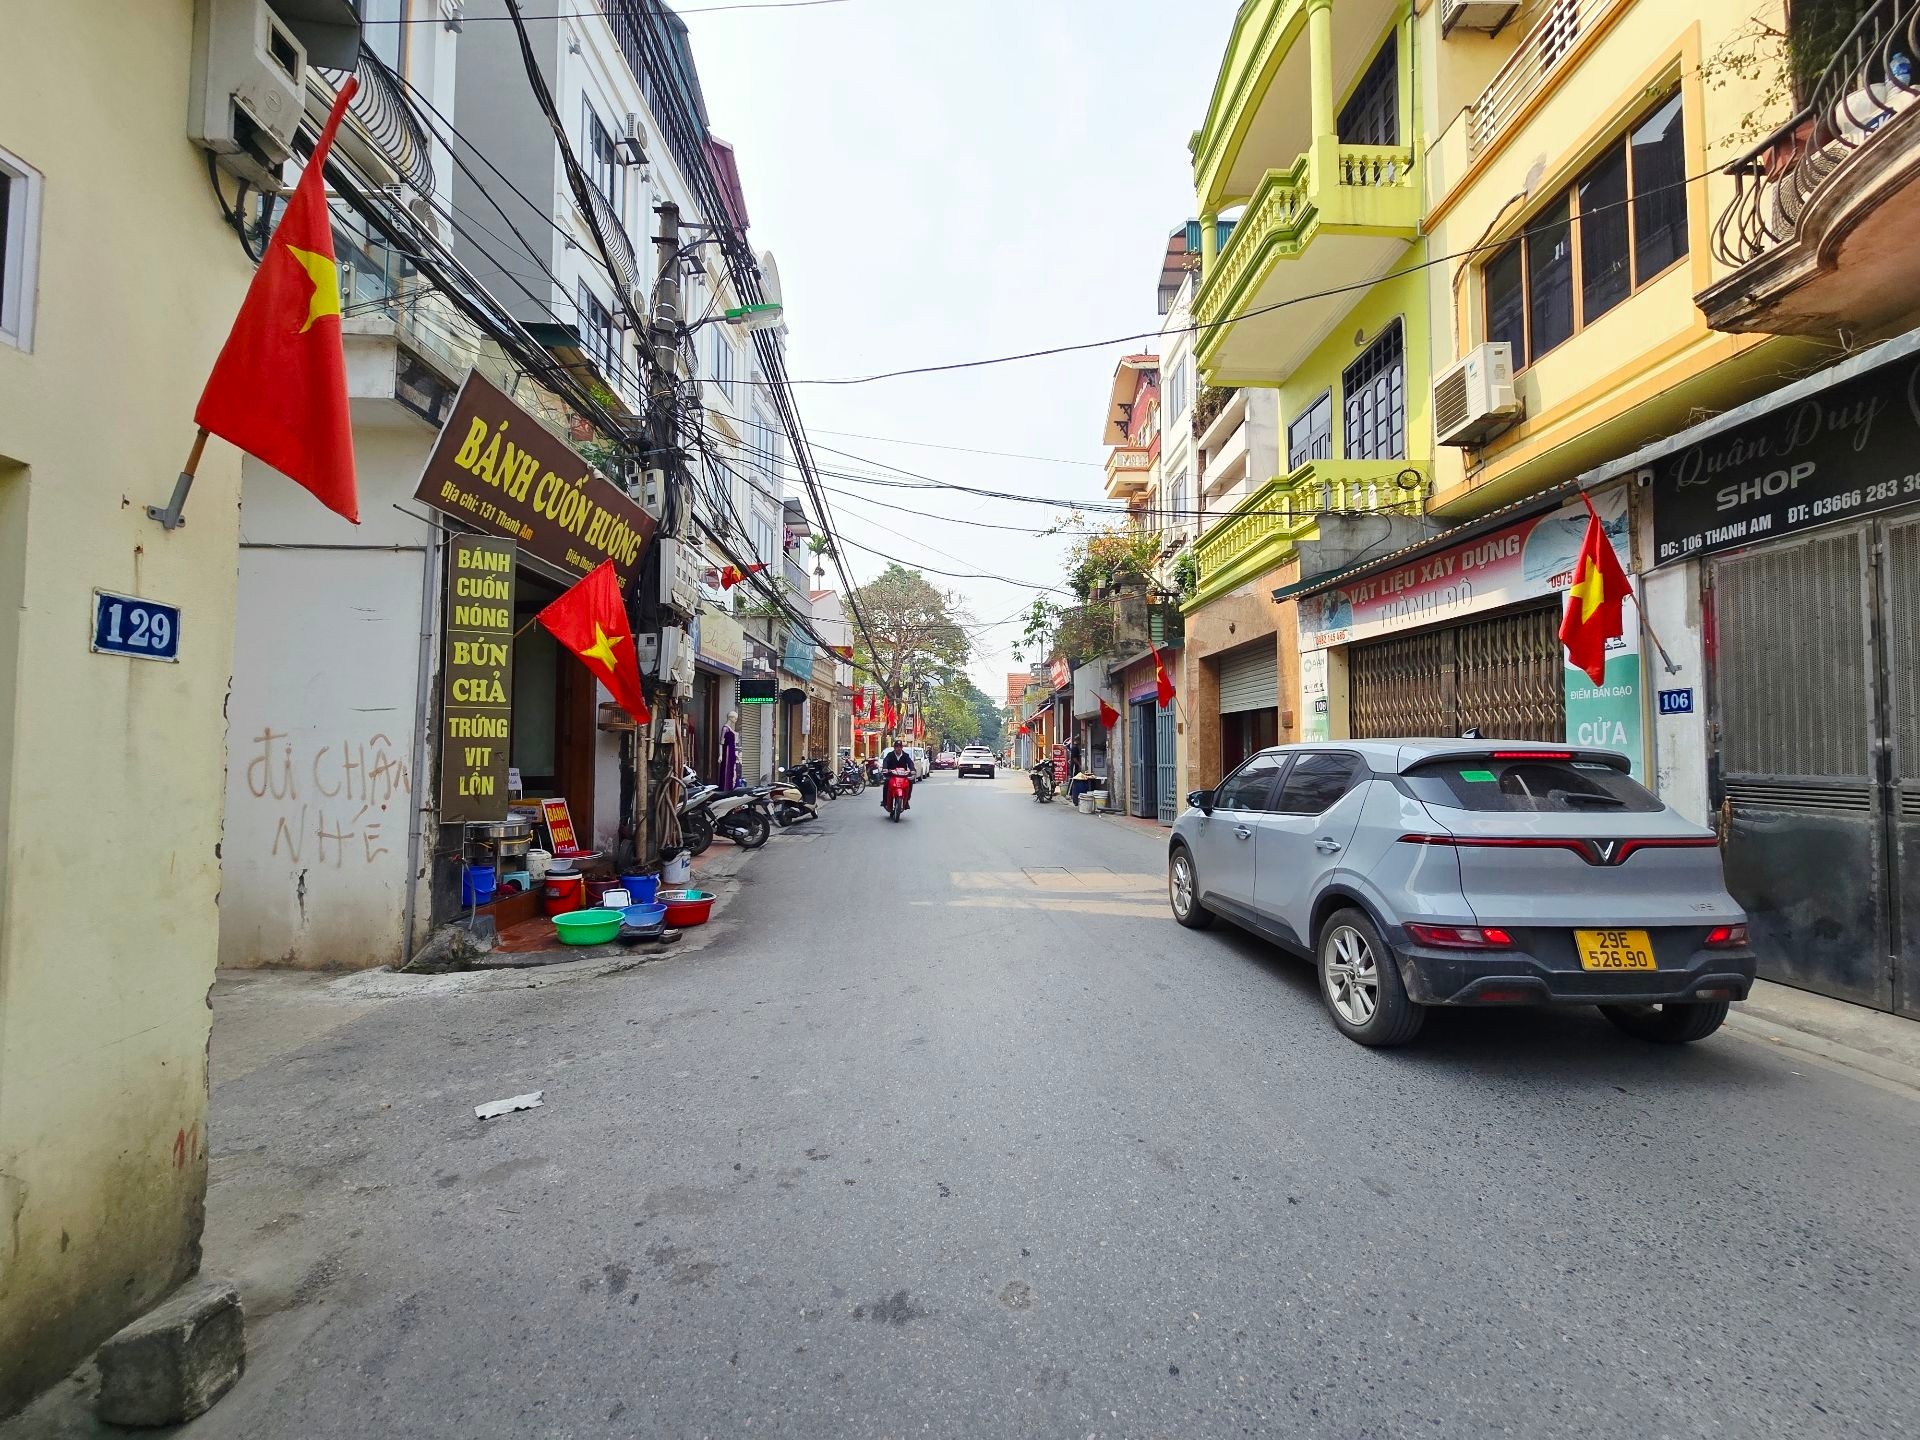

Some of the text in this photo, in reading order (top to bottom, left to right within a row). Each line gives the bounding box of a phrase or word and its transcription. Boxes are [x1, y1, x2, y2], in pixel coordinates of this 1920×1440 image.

[454, 415, 642, 567] BÁNH CUỐN HƯƠNG
[1716, 461, 1816, 511] SHOP
[440, 480, 460, 502] Địa
[479, 501, 496, 521] 131
[495, 509, 521, 535] Thanh
[519, 523, 534, 541] Am
[1682, 534, 1703, 552] 106
[1705, 521, 1747, 546] THANH
[1749, 514, 1772, 534] AM
[1813, 489, 1861, 517] 03666
[1866, 479, 1898, 503] 283
[457, 546, 510, 572] BÁNH
[1350, 534, 1520, 605] VẬT LIỆU XÂY DỰNG
[456, 574, 509, 600] CUỐN
[1551, 571, 1572, 588] 0975
[106, 603, 171, 650] 129
[455, 602, 509, 628] NÓNG
[453, 636, 508, 667] BÚN
[452, 671, 506, 703] CHẢ
[1612, 685, 1633, 698] GẠO
[1662, 692, 1689, 710] 106
[449, 713, 508, 738] TRỨNG
[1577, 716, 1628, 745] CỬA
[464, 747, 492, 771] VỊT
[547, 804, 568, 822] BÁNH
[552, 824, 573, 844] KHÚC
[1597, 931, 1631, 949] 29E
[1589, 950, 1648, 968] 526.90
